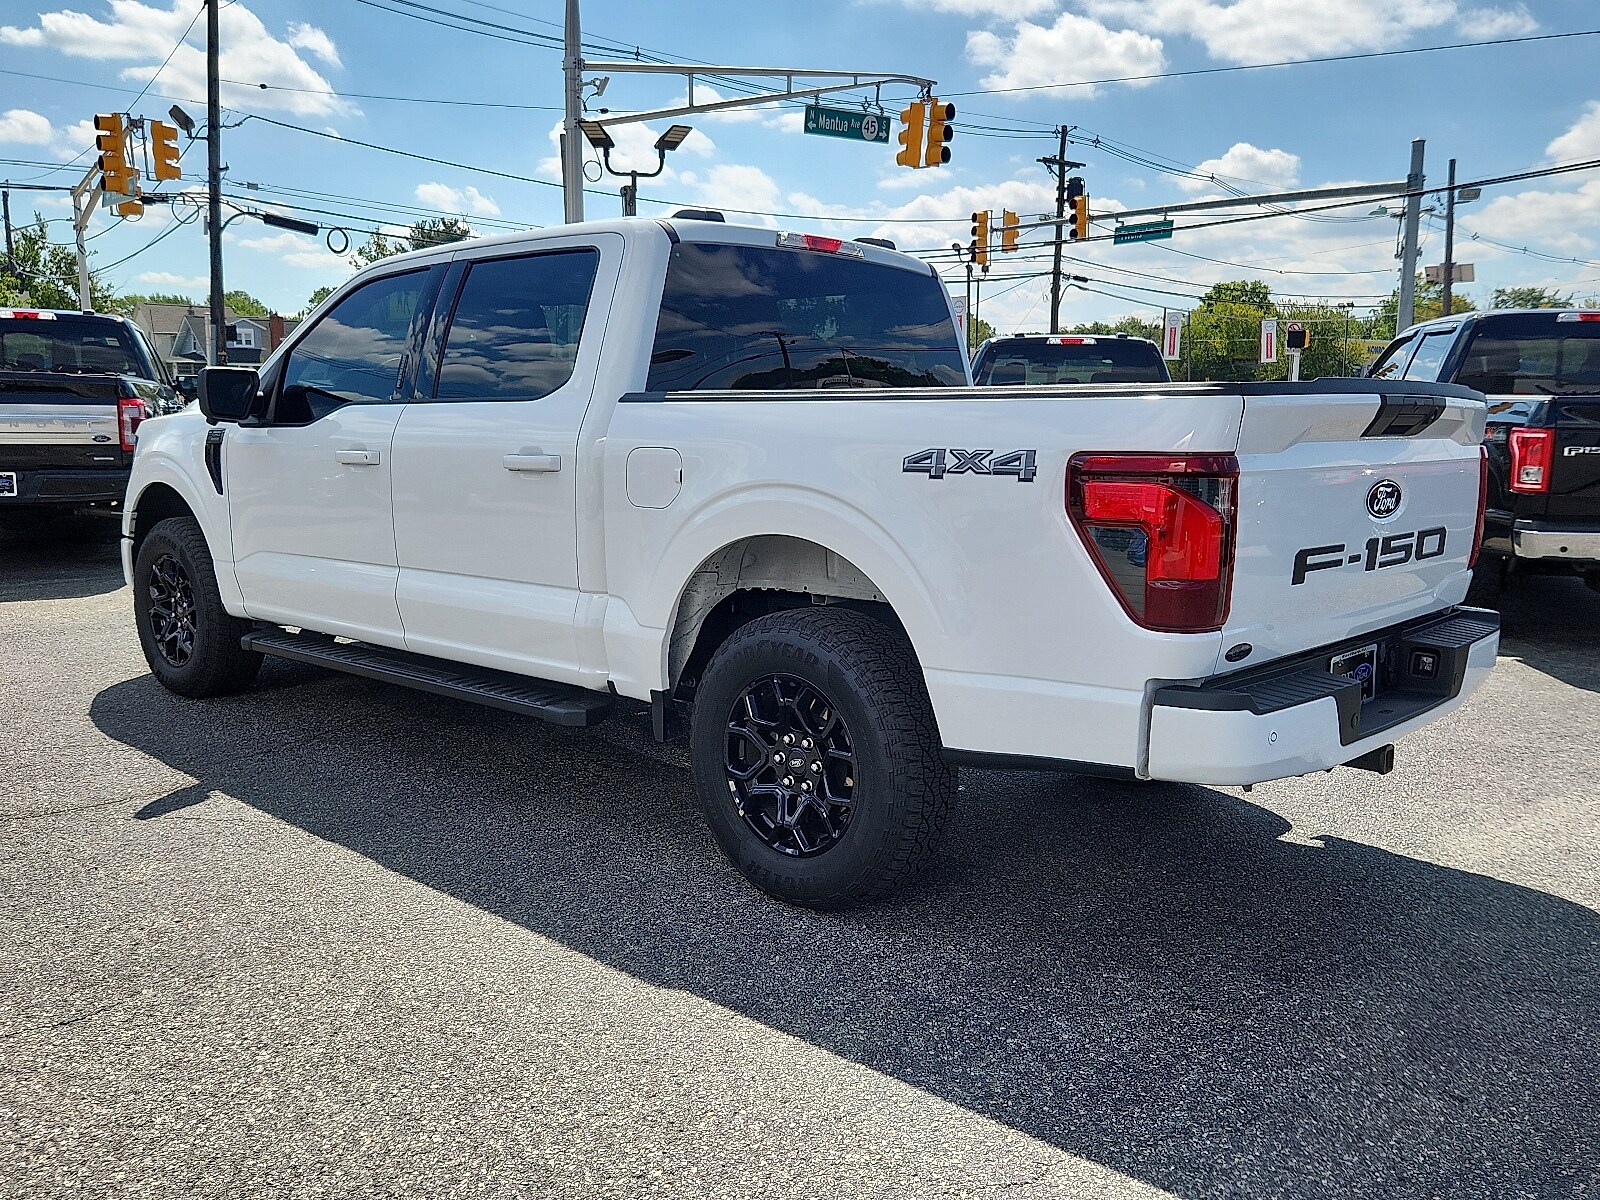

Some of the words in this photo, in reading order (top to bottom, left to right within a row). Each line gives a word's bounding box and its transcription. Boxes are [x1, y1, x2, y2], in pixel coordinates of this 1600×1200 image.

[809, 109, 815, 120] N
[818, 114, 848, 132] Mantua
[850, 118, 861, 129] Ave
[863, 119, 877, 135] 45
[882, 120, 887, 130] S
[1373, 486, 1398, 511] Ford
[1291, 526, 1447, 585] F-150
